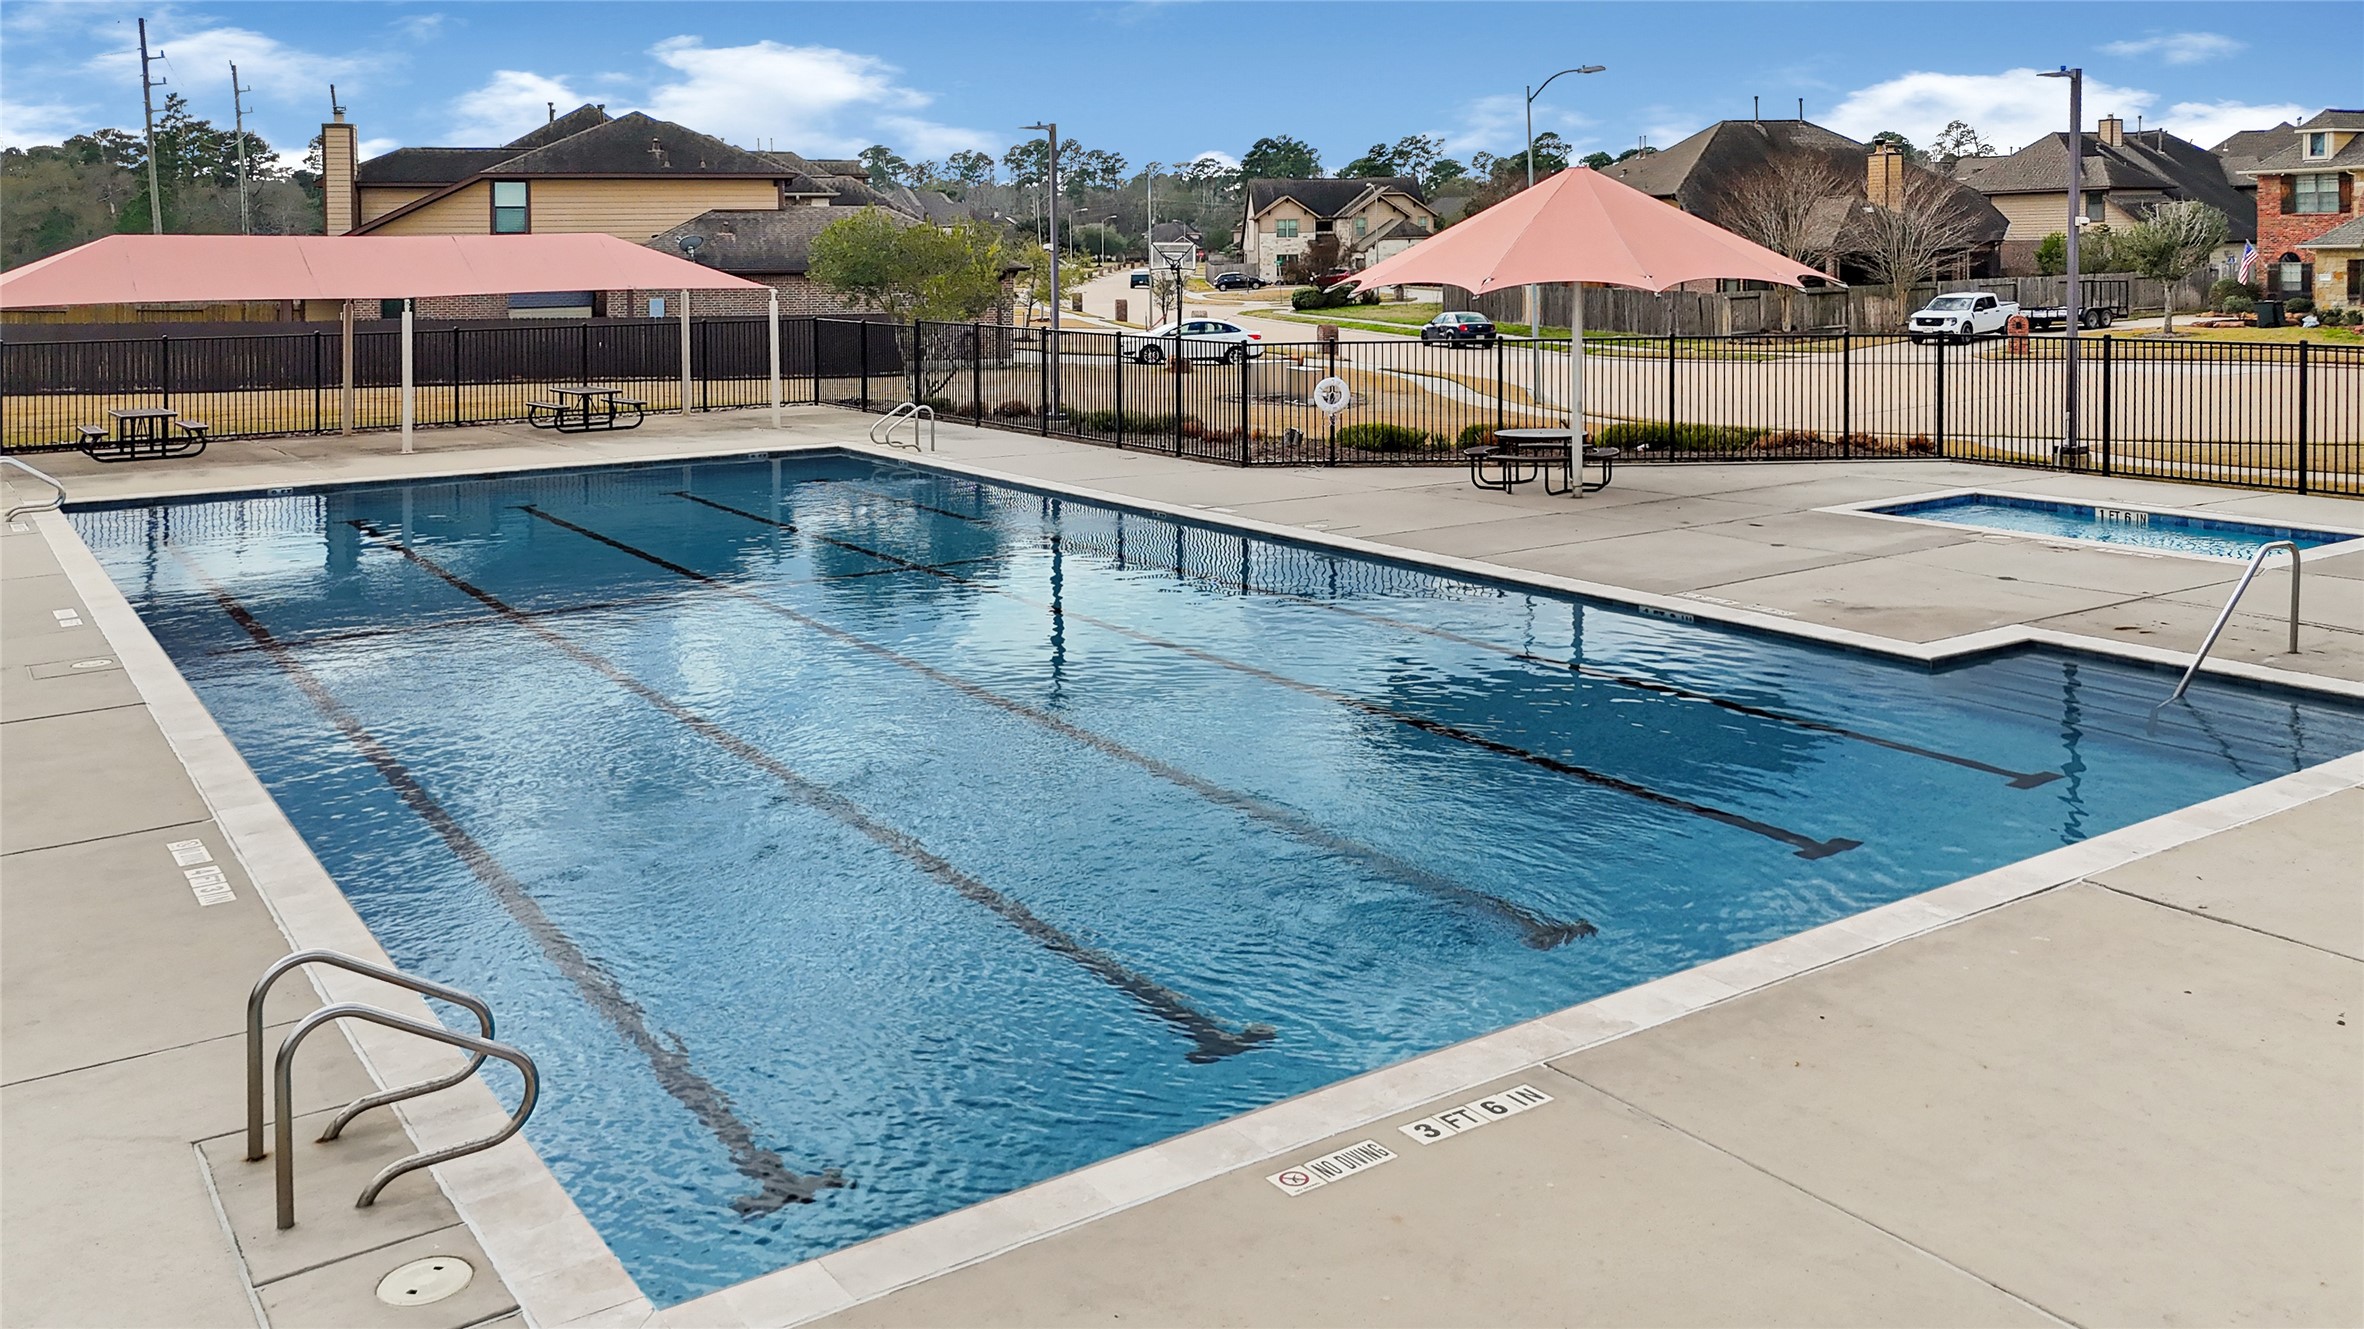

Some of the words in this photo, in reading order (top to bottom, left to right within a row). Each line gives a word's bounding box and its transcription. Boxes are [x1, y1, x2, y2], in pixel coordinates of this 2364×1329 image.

[2099, 509, 2105, 523] 1
[2109, 510, 2120, 524] FT
[2124, 512, 2131, 525] 6
[2136, 513, 2147, 527] IN
[1414, 1123, 1441, 1138] 3
[1439, 1109, 1478, 1129] FT
[1480, 1101, 1508, 1115] 6
[1506, 1088, 1545, 1106] IN
[1310, 1160, 1343, 1179] NO
[1333, 1144, 1390, 1170] DIVING
